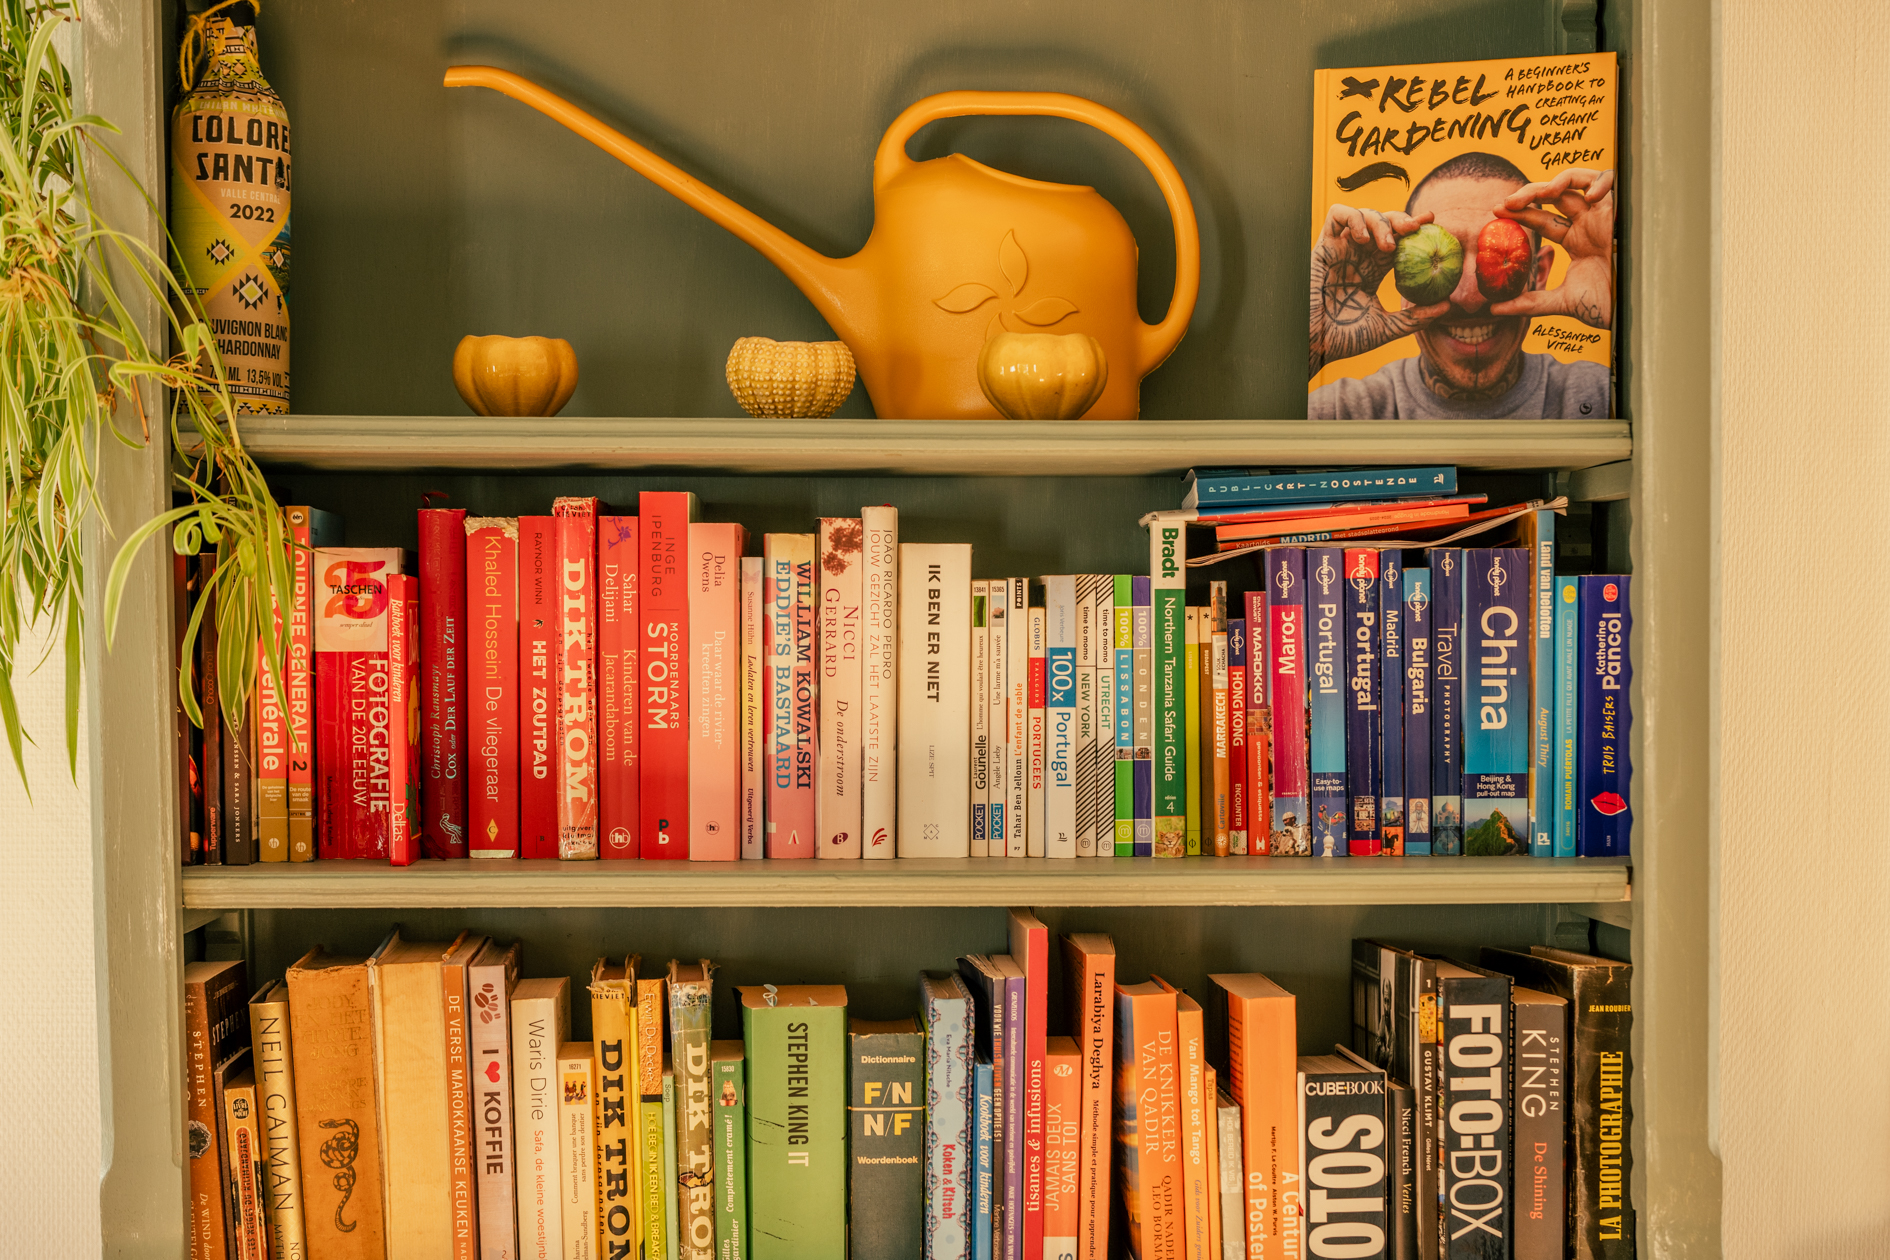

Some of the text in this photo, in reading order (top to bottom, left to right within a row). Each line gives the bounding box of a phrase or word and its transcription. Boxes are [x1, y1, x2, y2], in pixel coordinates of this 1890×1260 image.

[1378, 73, 1500, 113] REBEL
[1504, 62, 1591, 81] A BEGINNER'S
[1506, 77, 1606, 98] HANDBOOK TO
[1535, 95, 1604, 108] CREATING AN
[1335, 103, 1531, 158] GARDENING
[1530, 126, 1587, 151] URBAN
[1540, 110, 1599, 127] ORGANIC
[1540, 148, 1605, 170] GARDEN
[230, 203, 275, 223] 2022
[1532, 323, 1601, 344] ALESSANDRO
[1547, 339, 1584, 354] VITALE
[1208, 483, 1272, 493] PUBLIC
[1276, 482, 1306, 491] ART
[1331, 477, 1417, 489] OOSTENDE
[534, 532, 543, 605] RAYNOR WINN
[651, 514, 663, 598] IPENBURG
[664, 536, 676, 576] INGE
[700, 551, 711, 593] Owens
[1162, 527, 1180, 579] Bradt
[330, 584, 382, 597] TASCHEN
[563, 558, 586, 651] DIK
[604, 563, 633, 623] Sahar Delijani
[882, 528, 895, 680] JOÃO RICARDO PEDRO
[1540, 540, 1553, 640] Land van beloften
[868, 528, 881, 783] JOUW GEZICHT ZAL HET LAATSTE ZIJN
[1033, 616, 1041, 652] GLOBUS
[1083, 627, 1090, 636] to
[1252, 627, 1263, 705] MAROKKO
[1279, 611, 1296, 676] Maroc
[1315, 603, 1338, 694] Portugal
[1352, 611, 1377, 711] Portugal
[1386, 609, 1400, 658] Madrid
[1480, 605, 1519, 731] China
[1596, 612, 1622, 691] Katherine Pancol
[481, 536, 504, 803] Khaled Hosseini De vliegeraar
[647, 622, 669, 730] STORM
[669, 622, 680, 730] MOORDENAARS
[775, 559, 791, 789] EDDIE'S BASTAARD
[796, 559, 811, 790] WILLIAM KOWALSKI
[1081, 672, 1091, 739] NEW YORK
[1101, 675, 1111, 730] UTRECHT
[1119, 610, 1129, 741] 100% LISSABON
[1137, 610, 1148, 741] 100% LONDEN
[1232, 671, 1244, 708] HONG
[1408, 637, 1429, 715] Bulgaria
[1437, 623, 1458, 765] Travel PHOTOGRAPHY
[369, 658, 390, 813] FOTOGRAFIE
[532, 640, 548, 780] HET ZOUTPAD
[564, 660, 590, 803] TROM
[601, 652, 616, 762] Jacarandaboom
[622, 648, 637, 767] Kinderen van de
[1051, 651, 1073, 788] 100x Portugal
[1232, 709, 1244, 747] KONG
[1537, 707, 1550, 768] August Thiry
[1603, 696, 1615, 775] TROIS BAISERS
[975, 734, 987, 791] Gounelle
[1013, 682, 1024, 839] Tahar Ben Jelloun L'enfant de sable
[1032, 716, 1042, 790] PORTUGEES
[1216, 691, 1227, 831] MARRAKECH Cartoville
[1477, 783, 1516, 792] Hong Kong
[1563, 739, 1572, 811] ROMAIN PUÉRTOLAS
[208, 806, 217, 852] Tupperware
[974, 804, 986, 841] POCKET
[1477, 791, 1516, 800] pull-out map
[1588, 1004, 1632, 1013] JEAN ROUBIER
[528, 1018, 548, 1121] Waris Dirie
[664, 1083, 672, 1104] Soep
[721, 1065, 736, 1073] 15830
[787, 1022, 809, 1167] STEPHEN KING IT
[860, 1054, 916, 1064] Dictionnaire
[1206, 1078, 1215, 1101] Tapas
[1423, 1049, 1432, 1094] GUSTAV
[1521, 1029, 1548, 1119] KING
[1550, 1036, 1560, 1112] STEPHEN
[259, 1016, 295, 1212] NEIL GAIMAN
[448, 995, 469, 1239] DE VERSE MAROKKAANSE KEUKEN
[1187, 1037, 1202, 1166] Van Mango tot Tango
[1424, 1095, 1433, 1128] KLIMT
[534, 1129, 545, 1207] Safa, de kleine
[724, 1114, 736, 1213] Complètement cramé!
[857, 1155, 919, 1165] Woordenboek
[1401, 1107, 1412, 1215] Nicci French Verlies
[1599, 1051, 1624, 1241] LA PHOTOGRAPHIE
